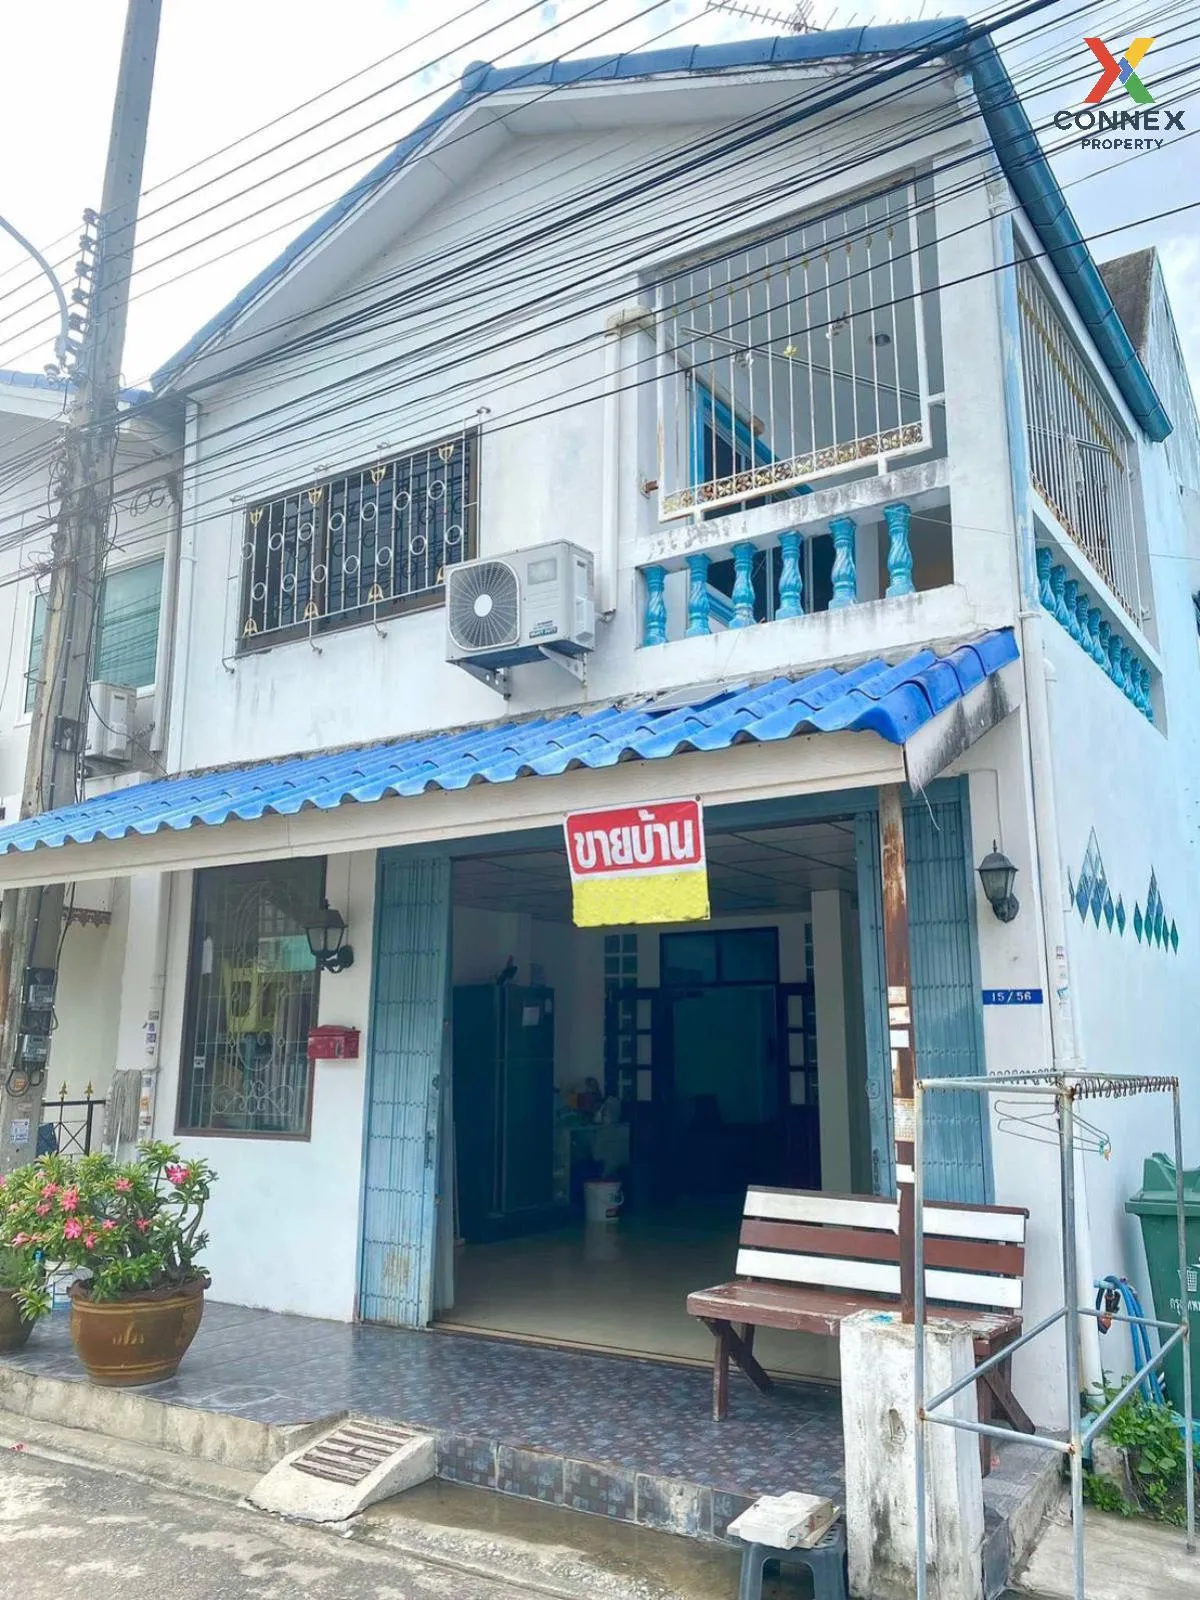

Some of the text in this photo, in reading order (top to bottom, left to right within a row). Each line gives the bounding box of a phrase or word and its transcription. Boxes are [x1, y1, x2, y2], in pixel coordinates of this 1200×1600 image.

[573, 809, 695, 869] ขายบ้าน
[992, 991, 1032, 1003] 15/56
